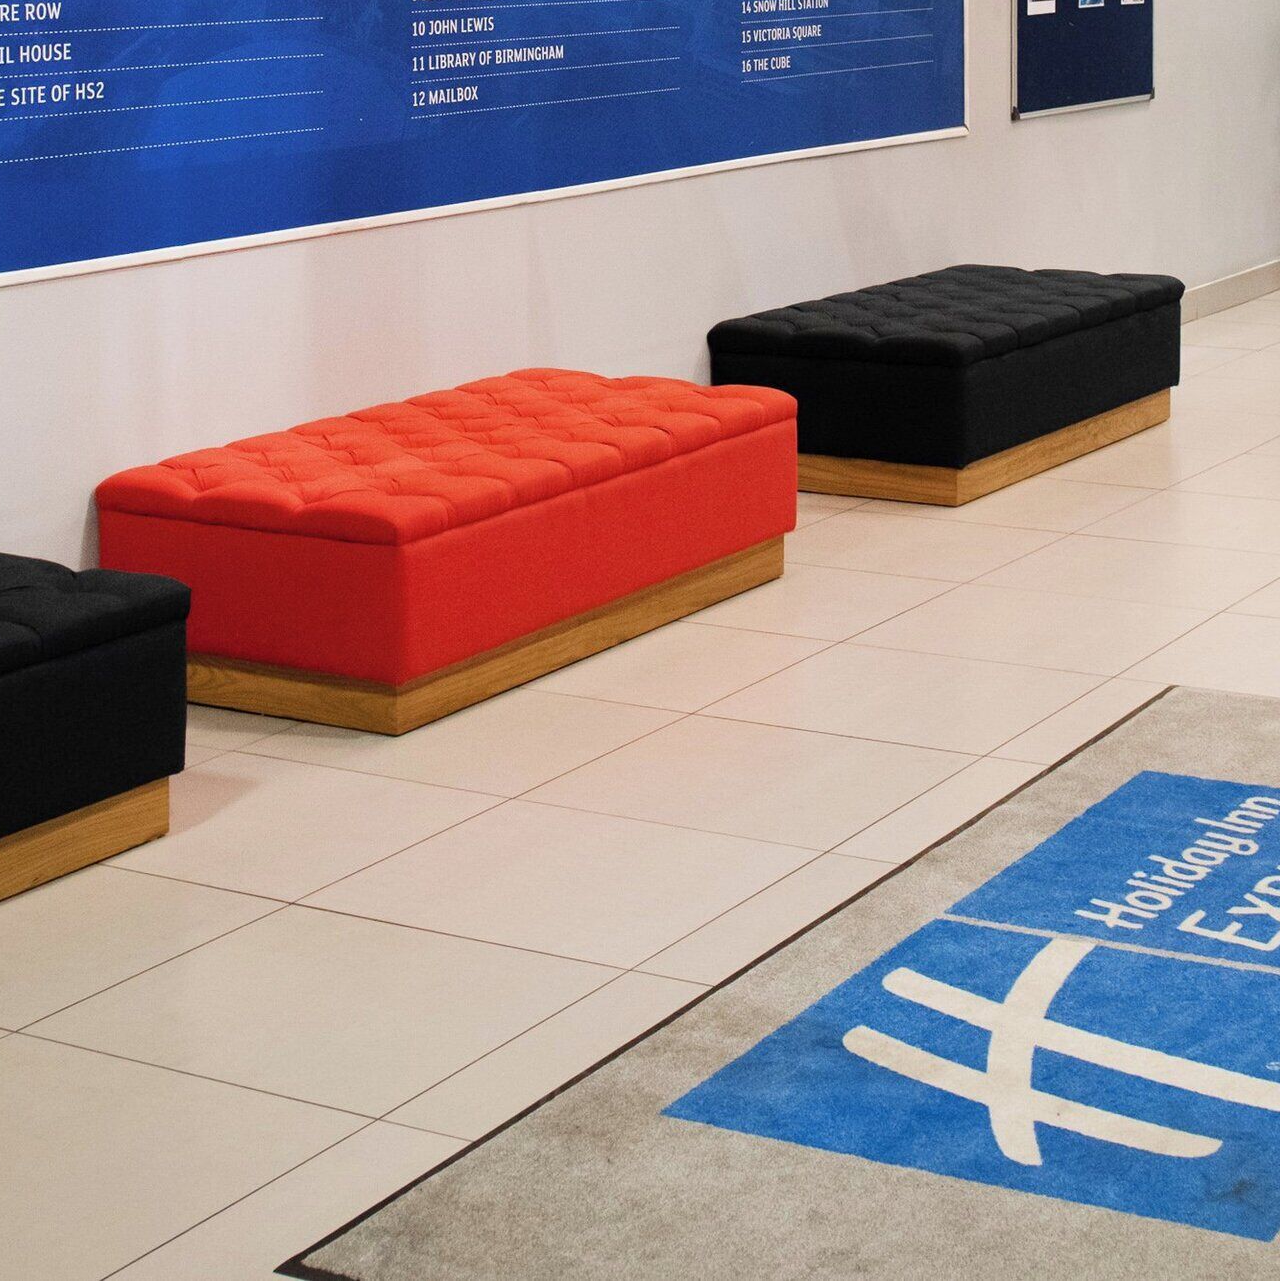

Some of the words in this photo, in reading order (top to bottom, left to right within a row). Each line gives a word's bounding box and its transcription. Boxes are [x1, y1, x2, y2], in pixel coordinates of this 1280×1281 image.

[24, 2, 62, 21] ROW
[741, 1, 752, 14] 14
[753, 0, 777, 13] SNOW
[412, 21, 426, 37] 10
[428, 19, 458, 36] JOHN
[460, 16, 495, 33] LEWIS
[741, 30, 752, 44] 15
[753, 26, 791, 42] VICTORIA
[792, 24, 822, 41] SQUARE
[19, 42, 72, 63] HOUSE
[412, 56, 425, 72] 11
[428, 52, 477, 71] LIBRARY
[478, 50, 493, 66] OF
[494, 44, 564, 65] BIRMINGHAM
[741, 59, 752, 73] 16
[753, 57, 769, 72] THE
[770, 55, 791, 70] CUBE
[10, 85, 47, 106] SITE
[51, 83, 71, 103] OF
[75, 81, 105, 101] HS2
[412, 90, 426, 107] 12
[428, 85, 479, 105] MAILBOX
[1073, 830, 1260, 930] Holiday
